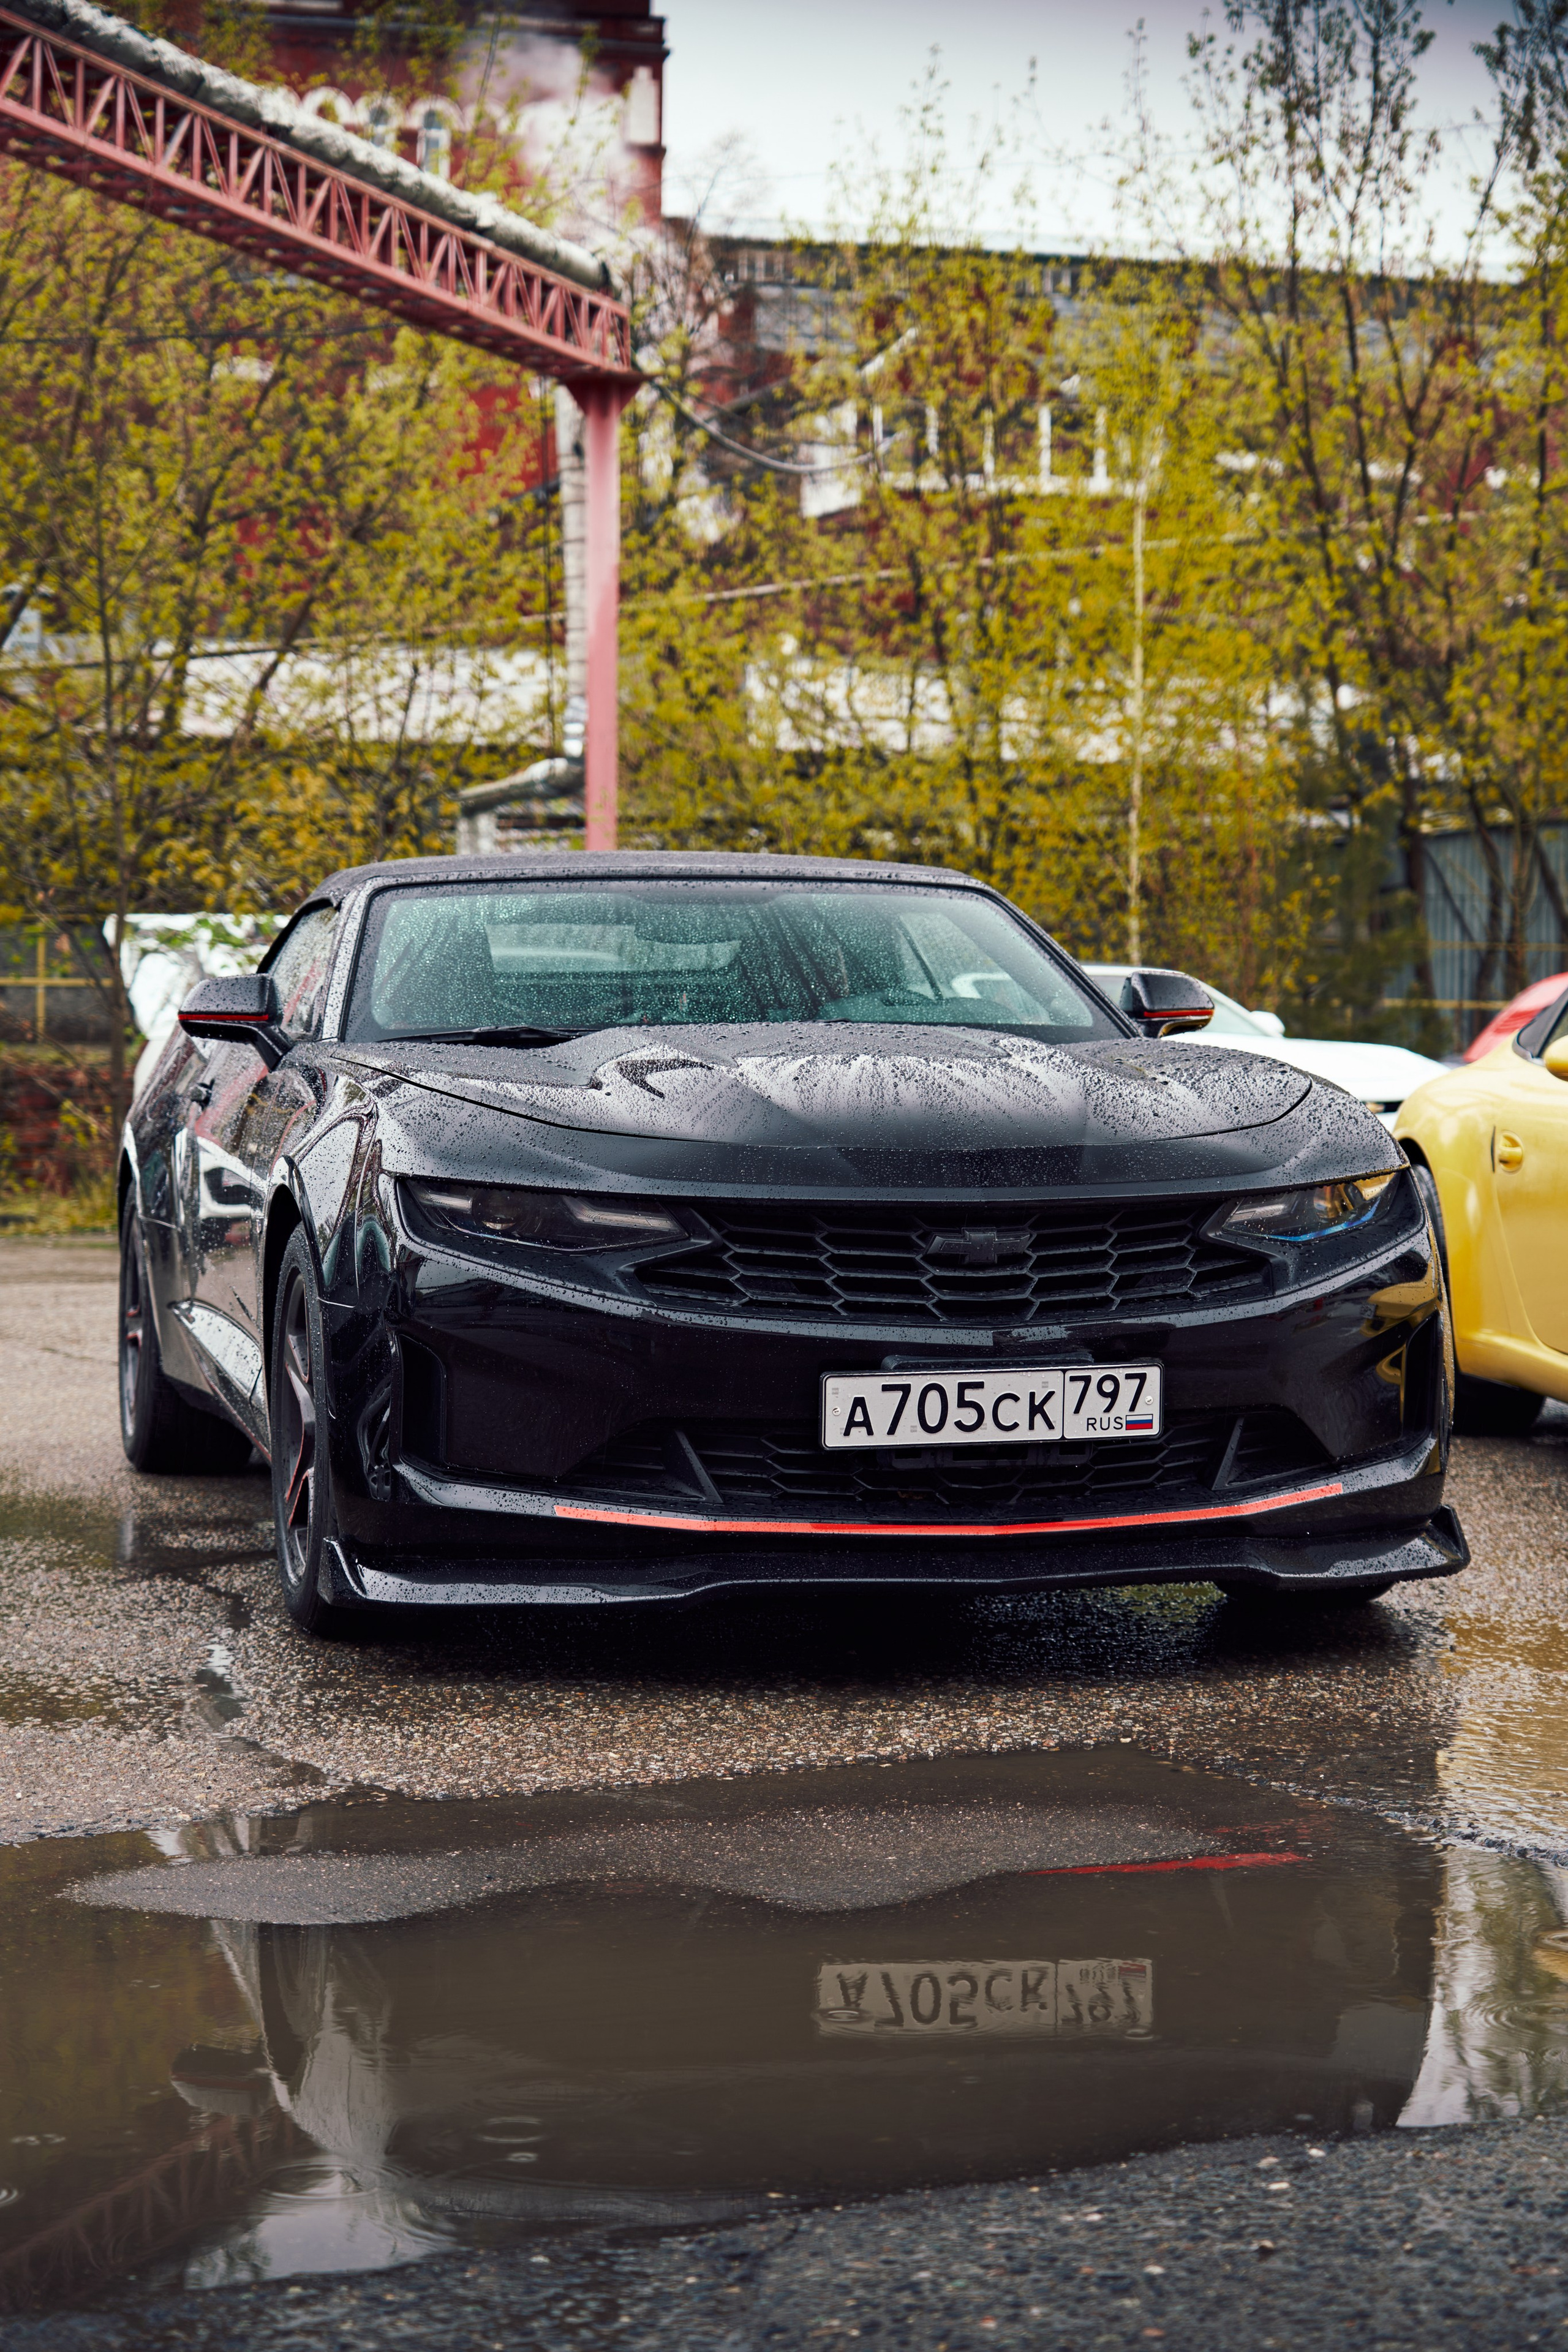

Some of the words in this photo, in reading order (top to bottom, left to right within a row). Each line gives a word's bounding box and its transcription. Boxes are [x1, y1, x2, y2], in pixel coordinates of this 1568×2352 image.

[843, 1381, 1055, 1436] A705CK
[1069, 1373, 1147, 1414] 797
[1087, 1416, 1123, 1431] RUS
